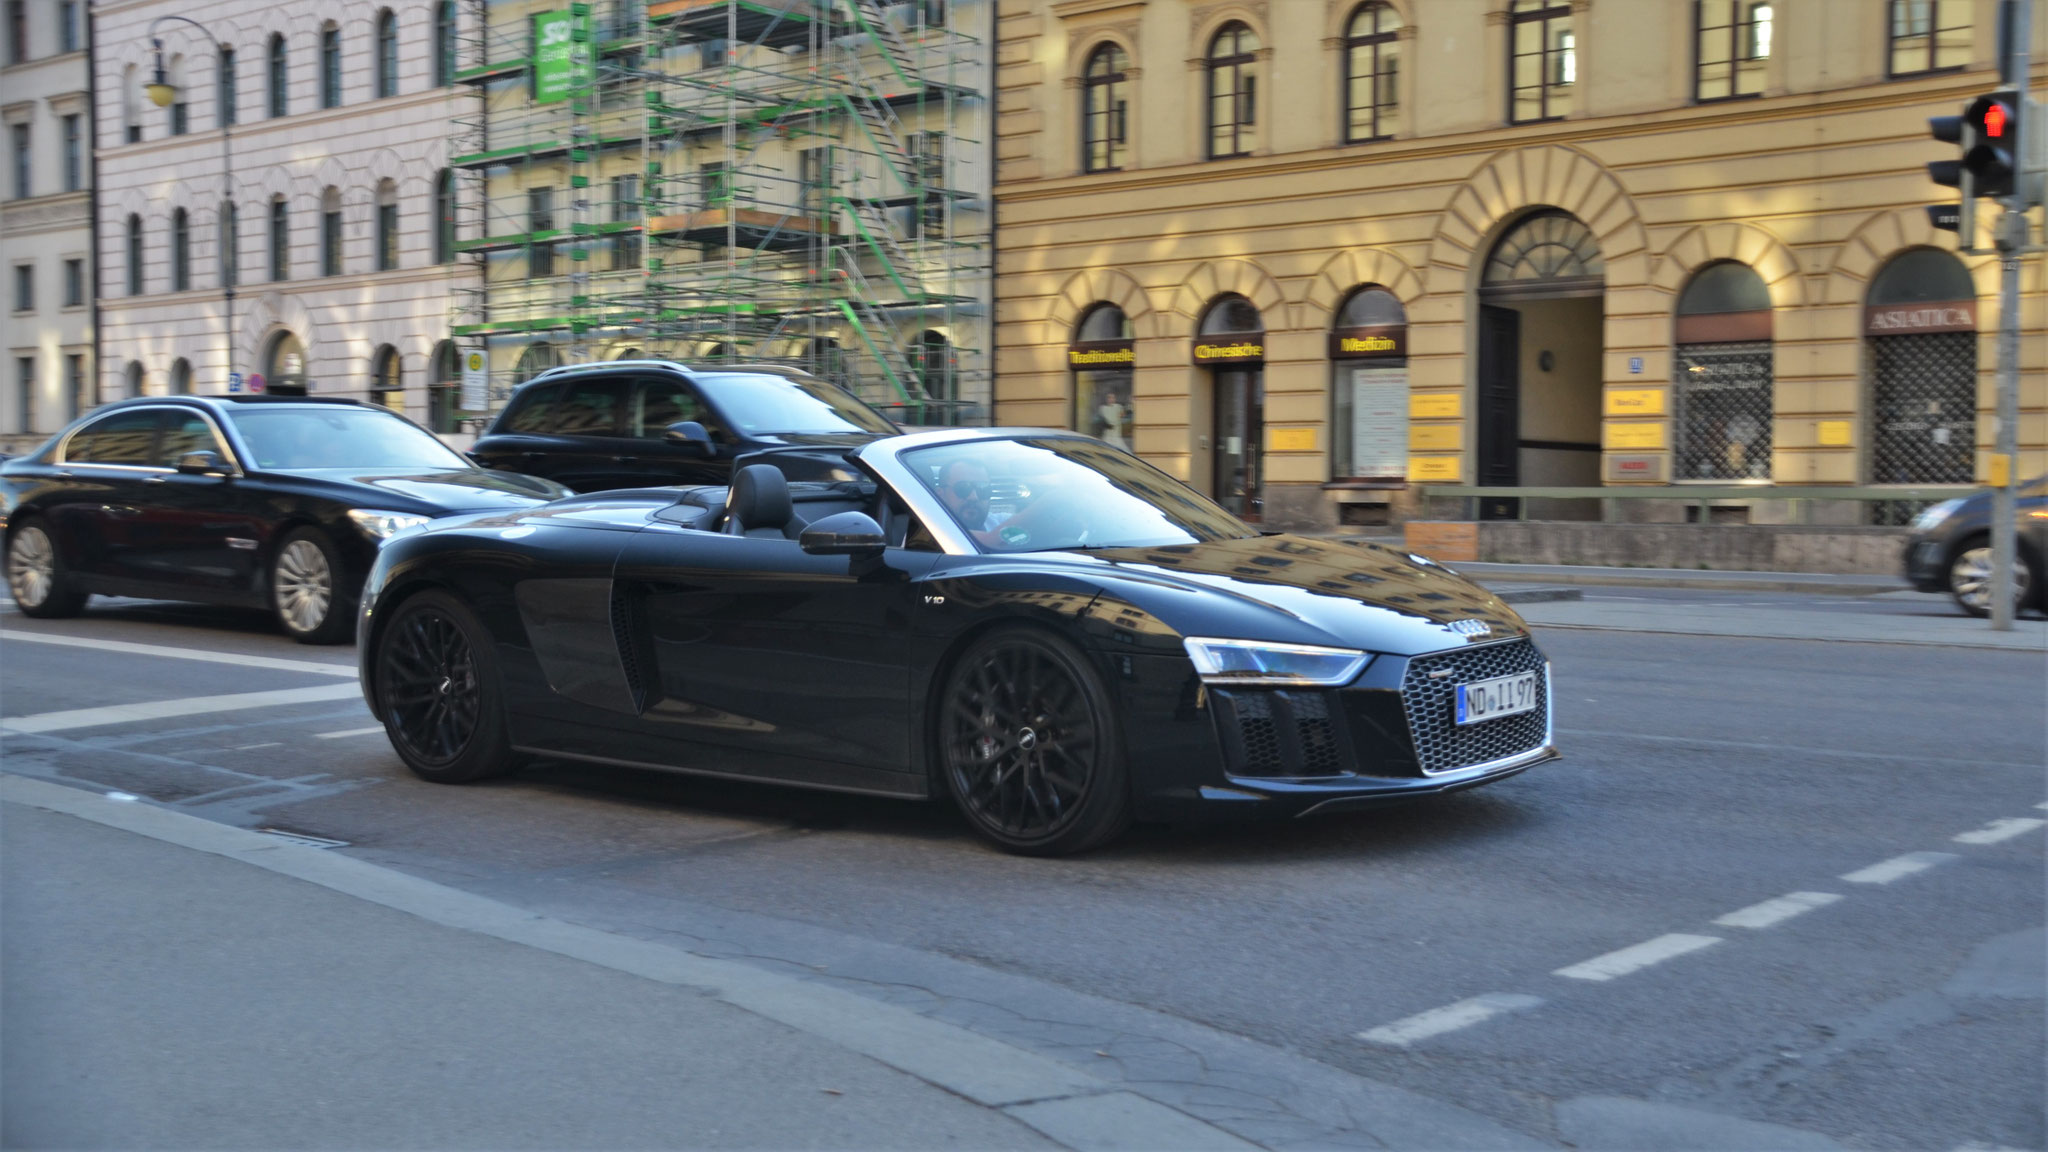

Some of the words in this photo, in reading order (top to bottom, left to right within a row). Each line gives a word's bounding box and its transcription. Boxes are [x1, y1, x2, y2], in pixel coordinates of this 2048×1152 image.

[1869, 308, 1974, 329] ASIATICA
[1340, 336, 1396, 352] Medizin
[924, 595, 945, 604] V10
[1466, 687, 1486, 717] ND
[1517, 678, 1533, 706] 97
